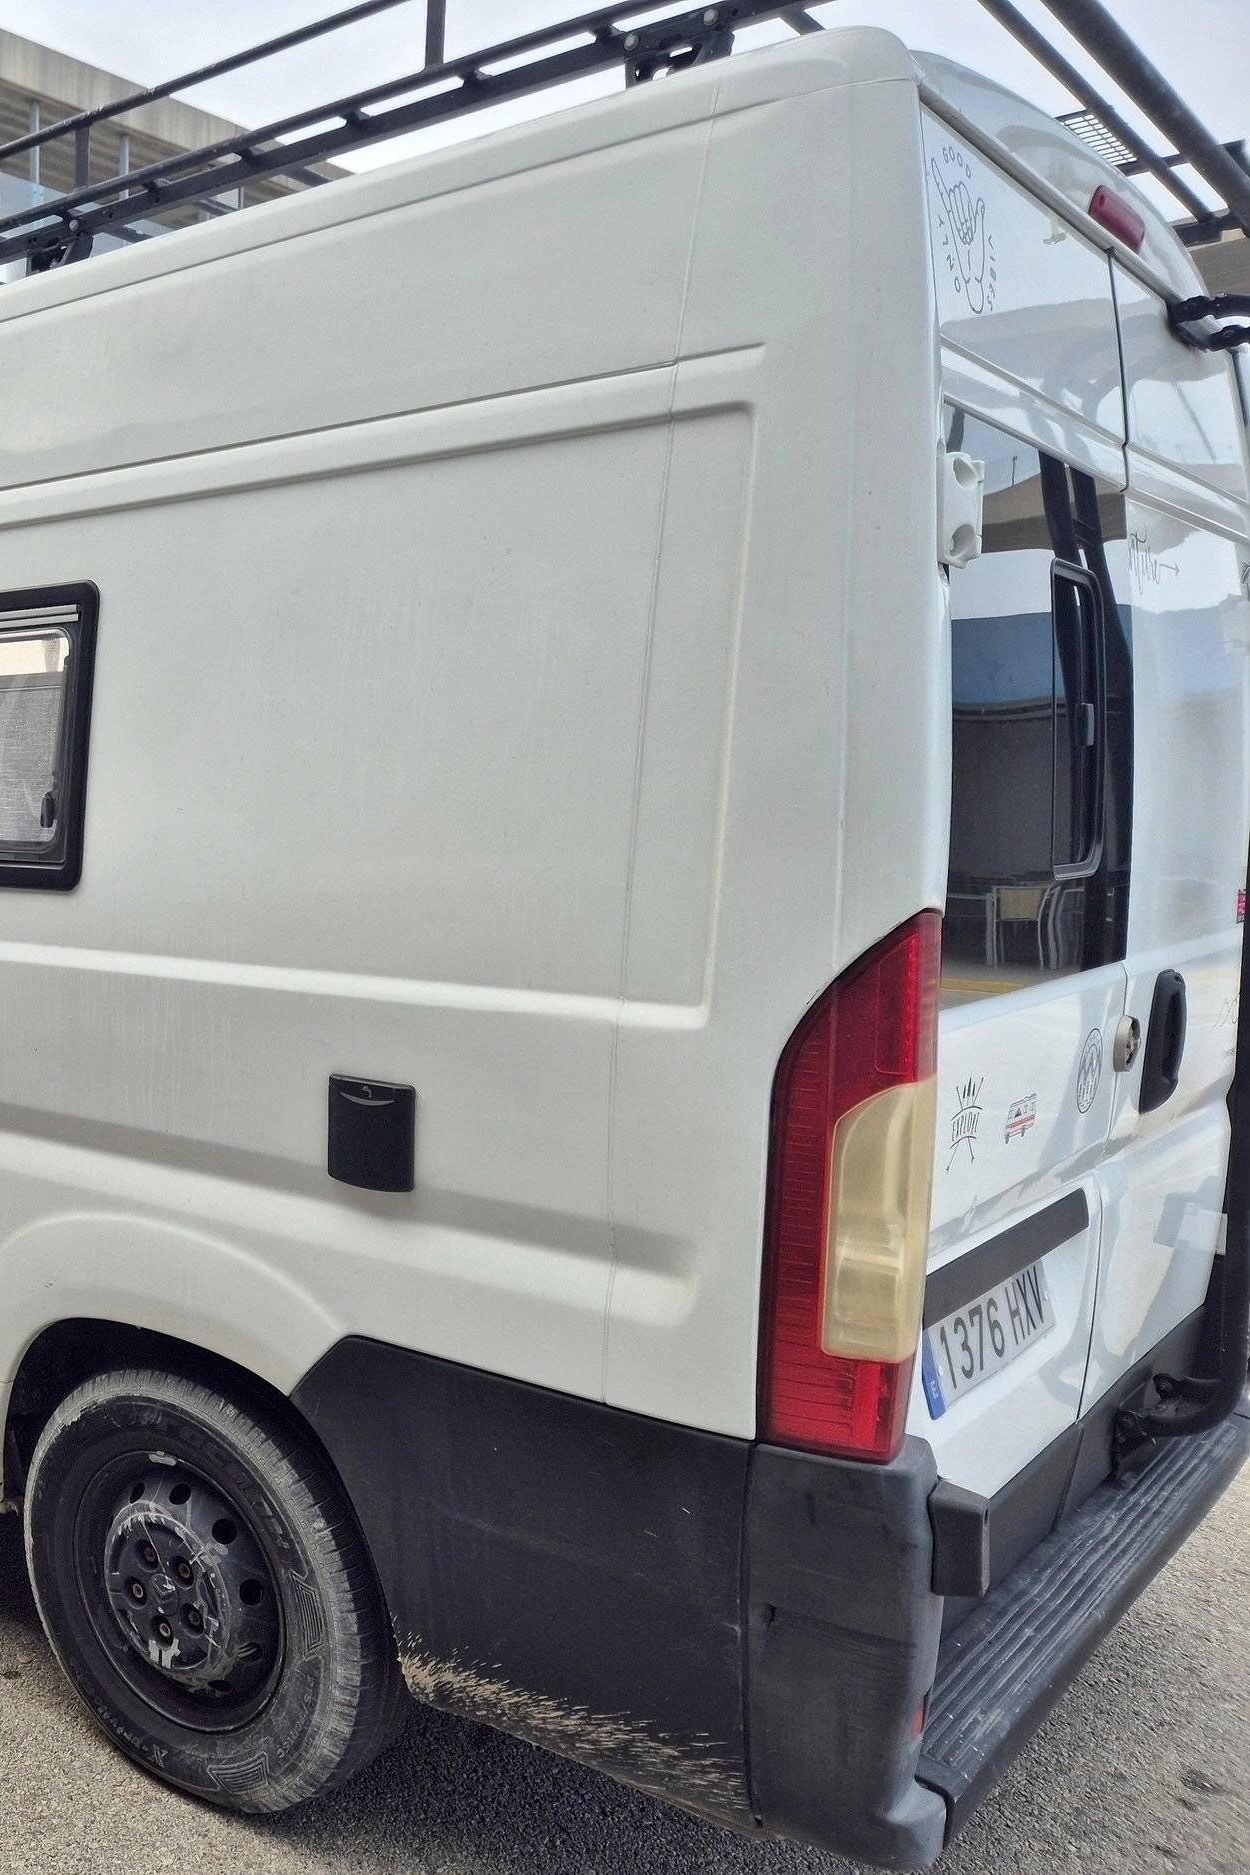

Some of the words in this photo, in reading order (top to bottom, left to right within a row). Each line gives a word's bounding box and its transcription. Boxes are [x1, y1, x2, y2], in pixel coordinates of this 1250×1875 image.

[940, 1297, 1005, 1389] 1376
[1005, 1265, 1044, 1345] HXV
[930, 1380, 939, 1399] E
